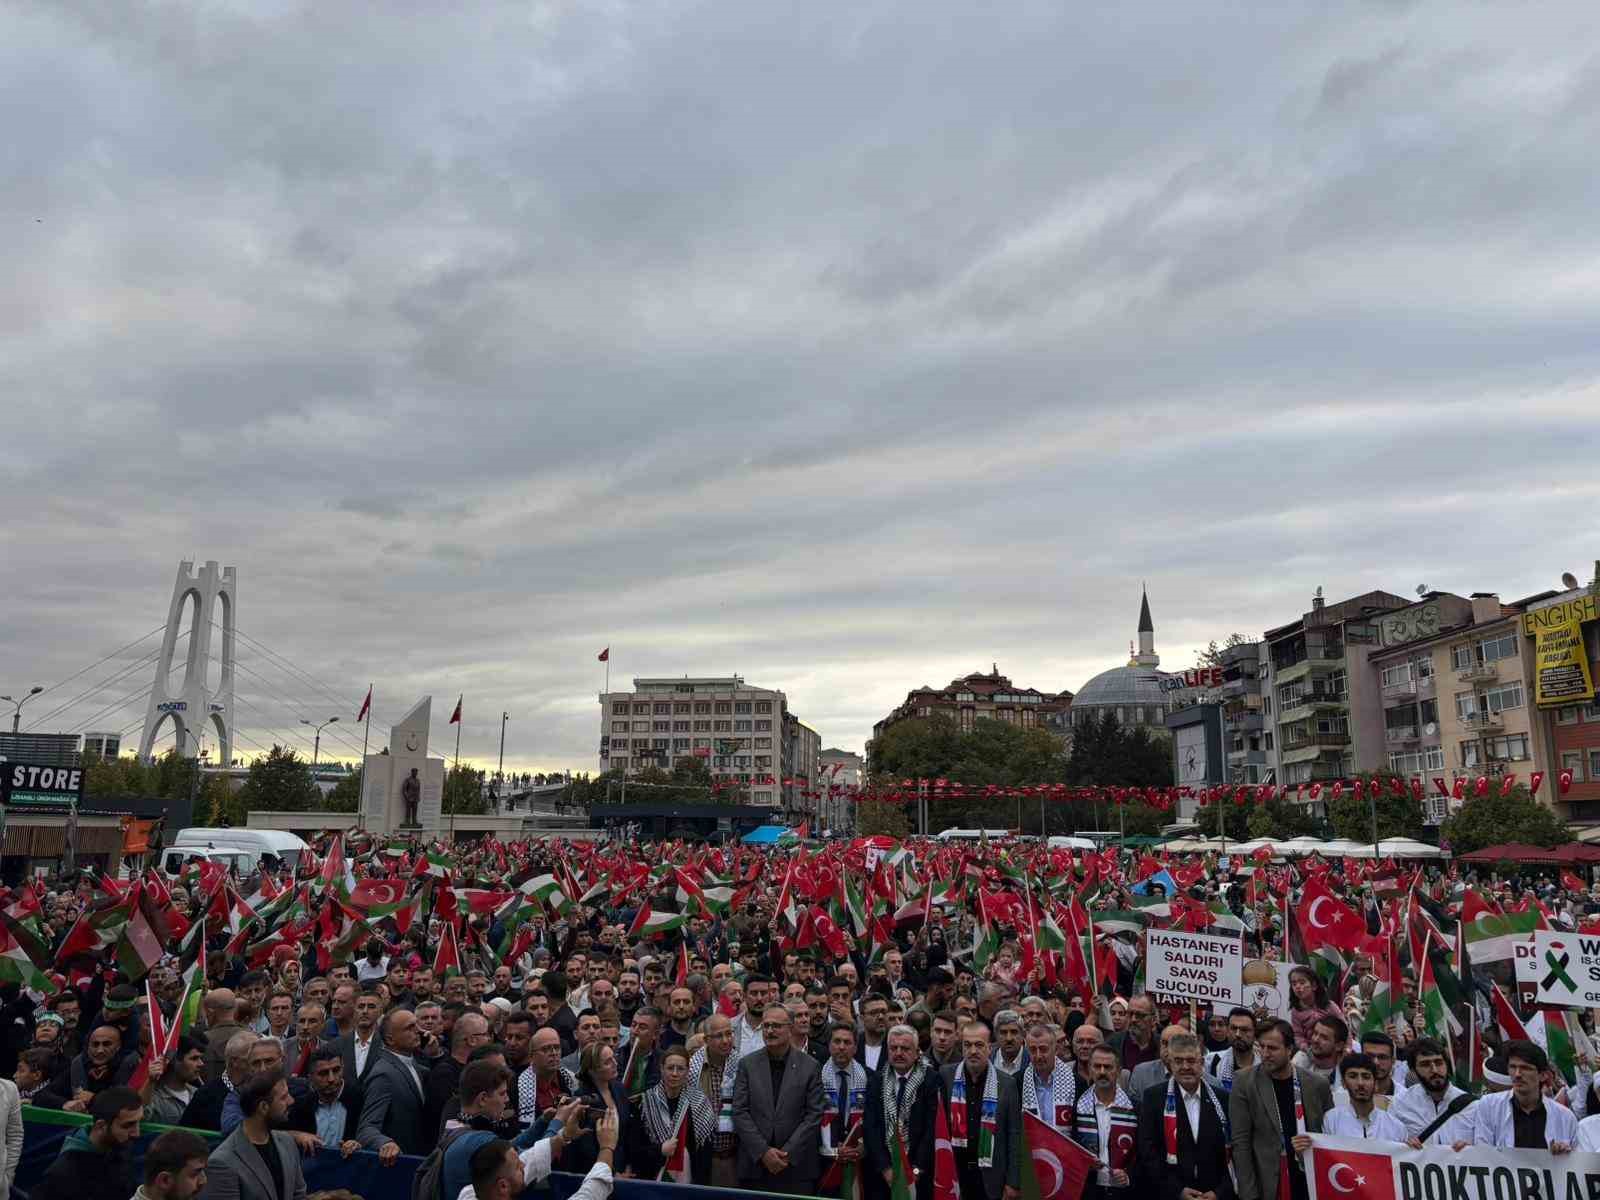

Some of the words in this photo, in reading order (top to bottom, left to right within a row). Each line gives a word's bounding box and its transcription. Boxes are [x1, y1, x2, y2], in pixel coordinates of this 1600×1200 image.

[12, 765, 82, 790] STORE
[1150, 936, 1239, 955] HASTANEYE
[1164, 951, 1224, 969] SALDIRI
[1169, 966, 1218, 984] SAVAŞ
